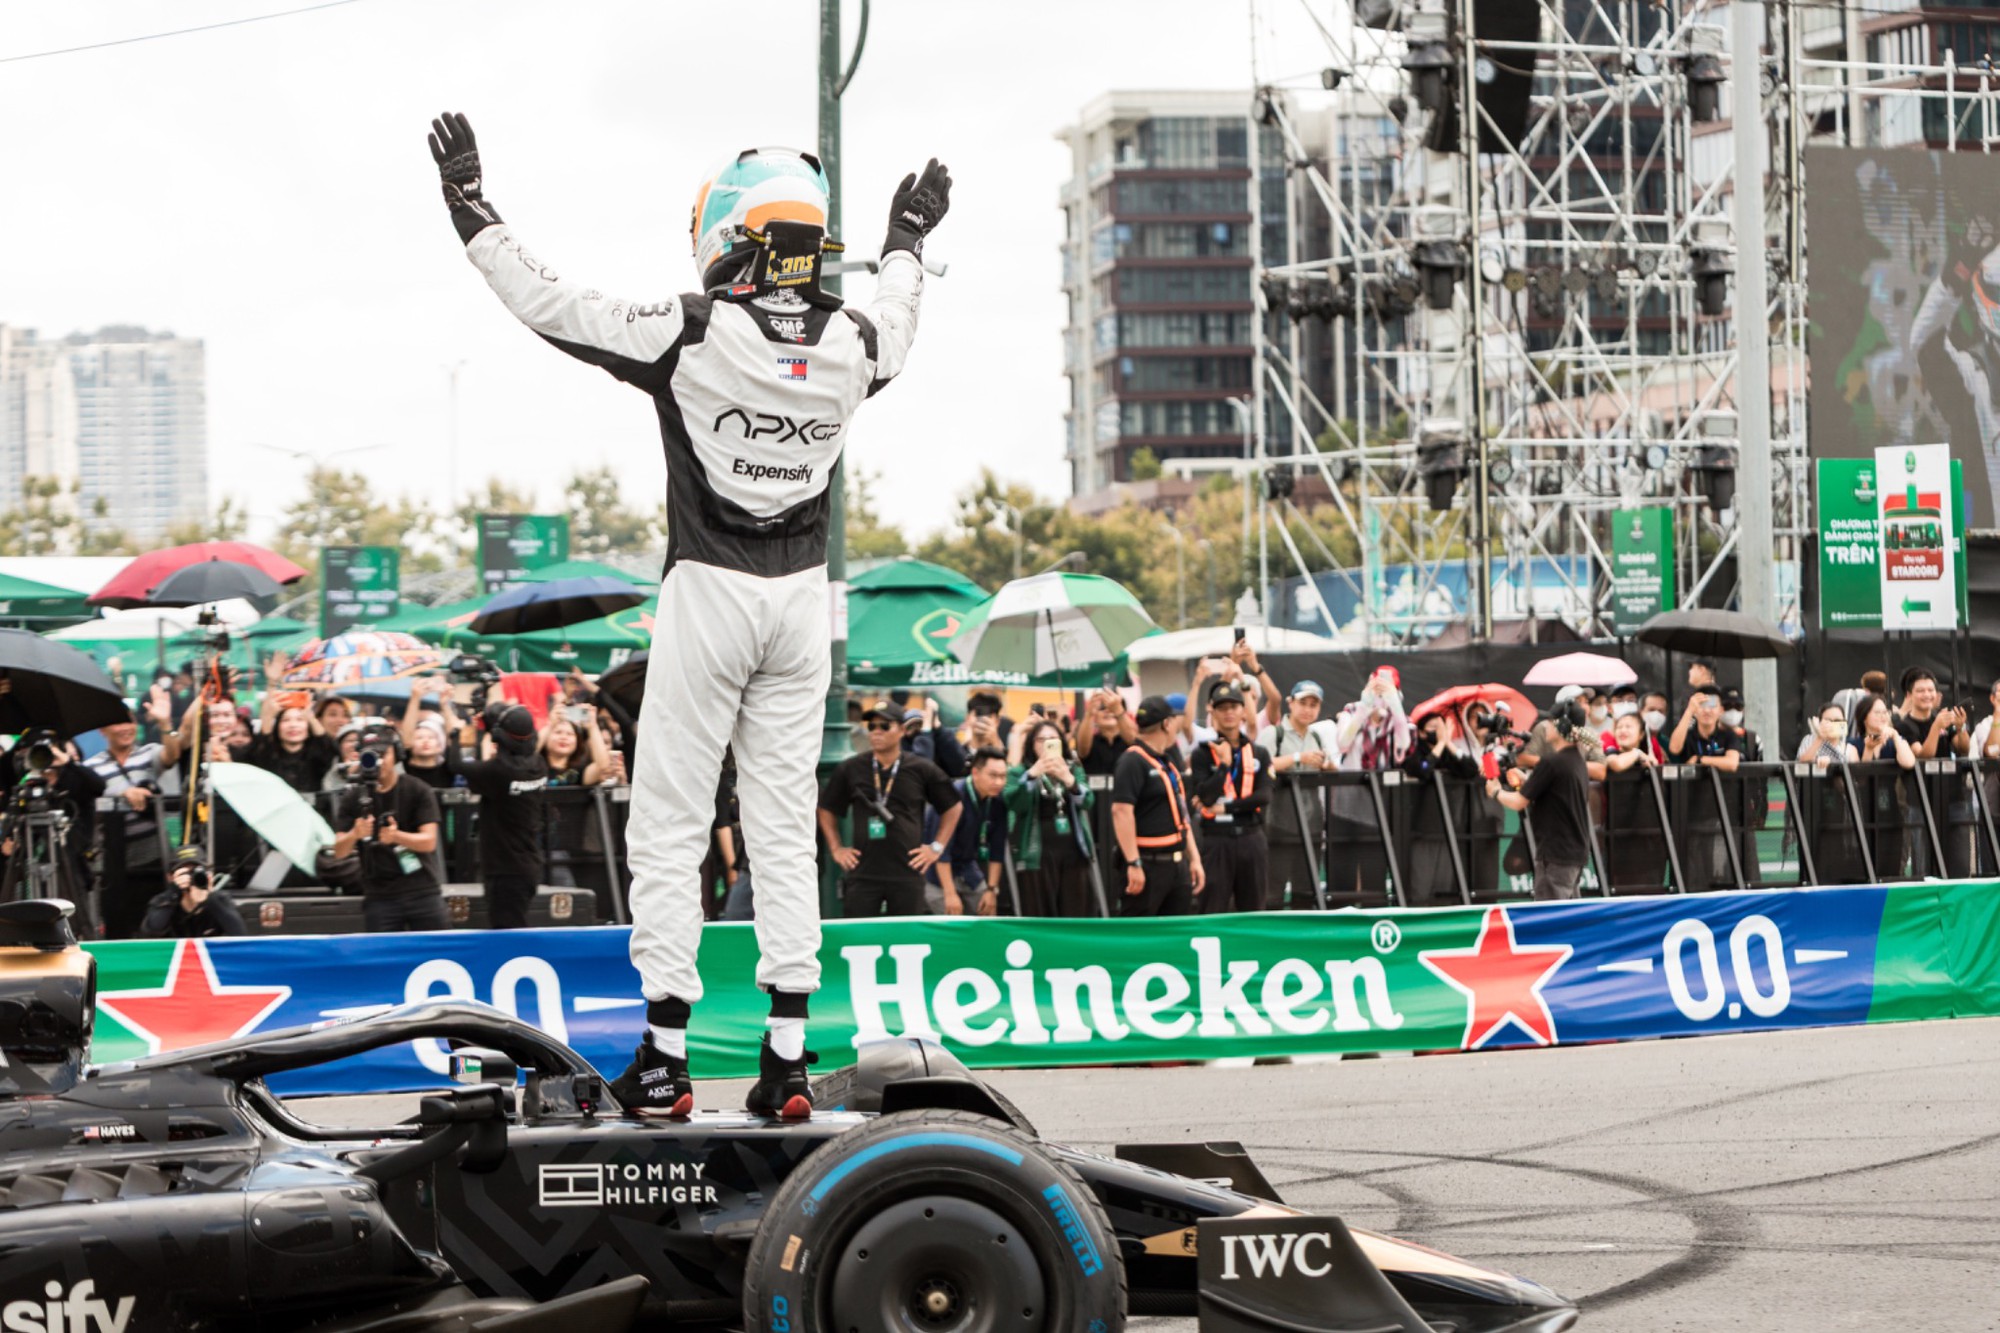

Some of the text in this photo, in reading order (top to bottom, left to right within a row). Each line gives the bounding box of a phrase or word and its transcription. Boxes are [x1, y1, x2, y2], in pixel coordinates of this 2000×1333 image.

[732, 458, 813, 484] Expensify
[1825, 542, 1875, 565] TRÊN
[840, 936, 1404, 1048] Heineken
[1662, 914, 1791, 1022] 0.0
[100, 1124, 136, 1137] HAYES
[605, 1163, 706, 1182] TOMMY
[606, 1186, 719, 1205] HILFIGER
[1042, 1182, 1104, 1278] PIRELLI
[1220, 1232, 1333, 1280] IWC
[0, 1278, 137, 1333] sify
